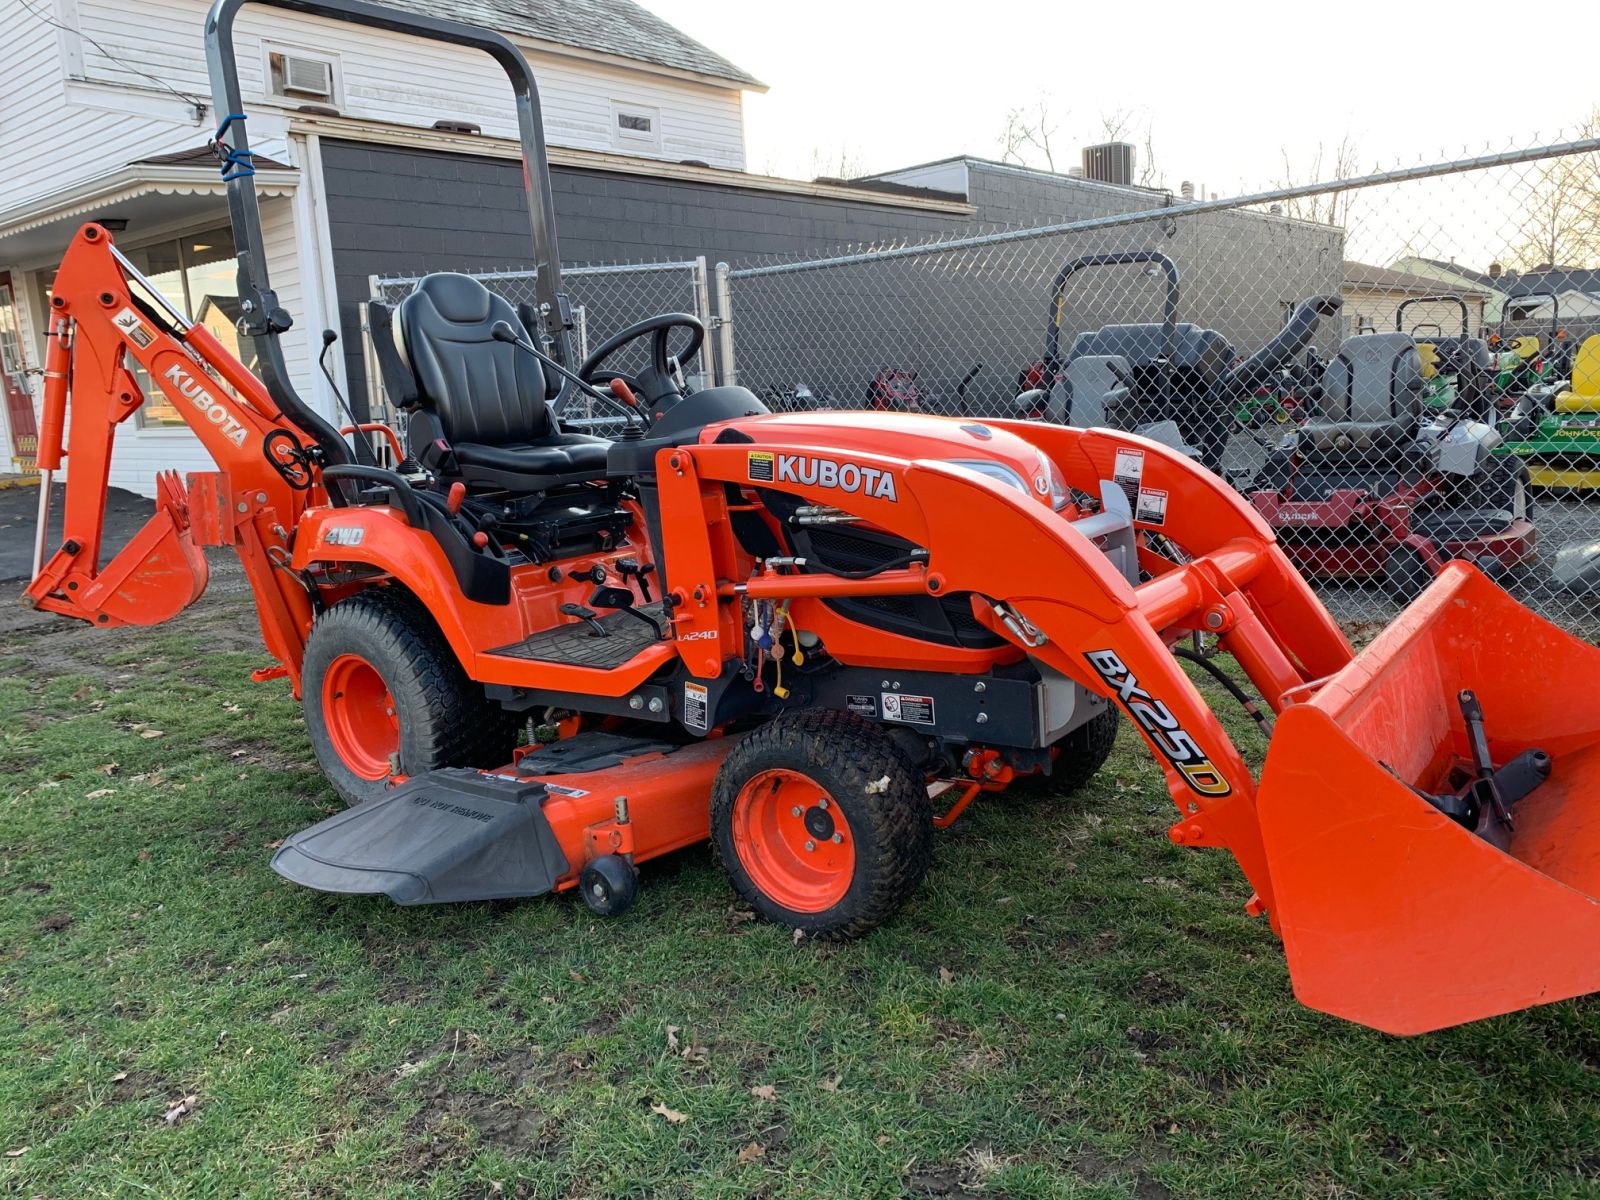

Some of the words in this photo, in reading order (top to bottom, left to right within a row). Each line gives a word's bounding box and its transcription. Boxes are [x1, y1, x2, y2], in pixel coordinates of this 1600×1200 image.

[164, 364, 248, 448] KUBOTA
[778, 454, 897, 503] KUBOTA
[324, 527, 365, 546] 4WD
[678, 630, 719, 642] LA240
[1082, 648, 1232, 798] BX25D
